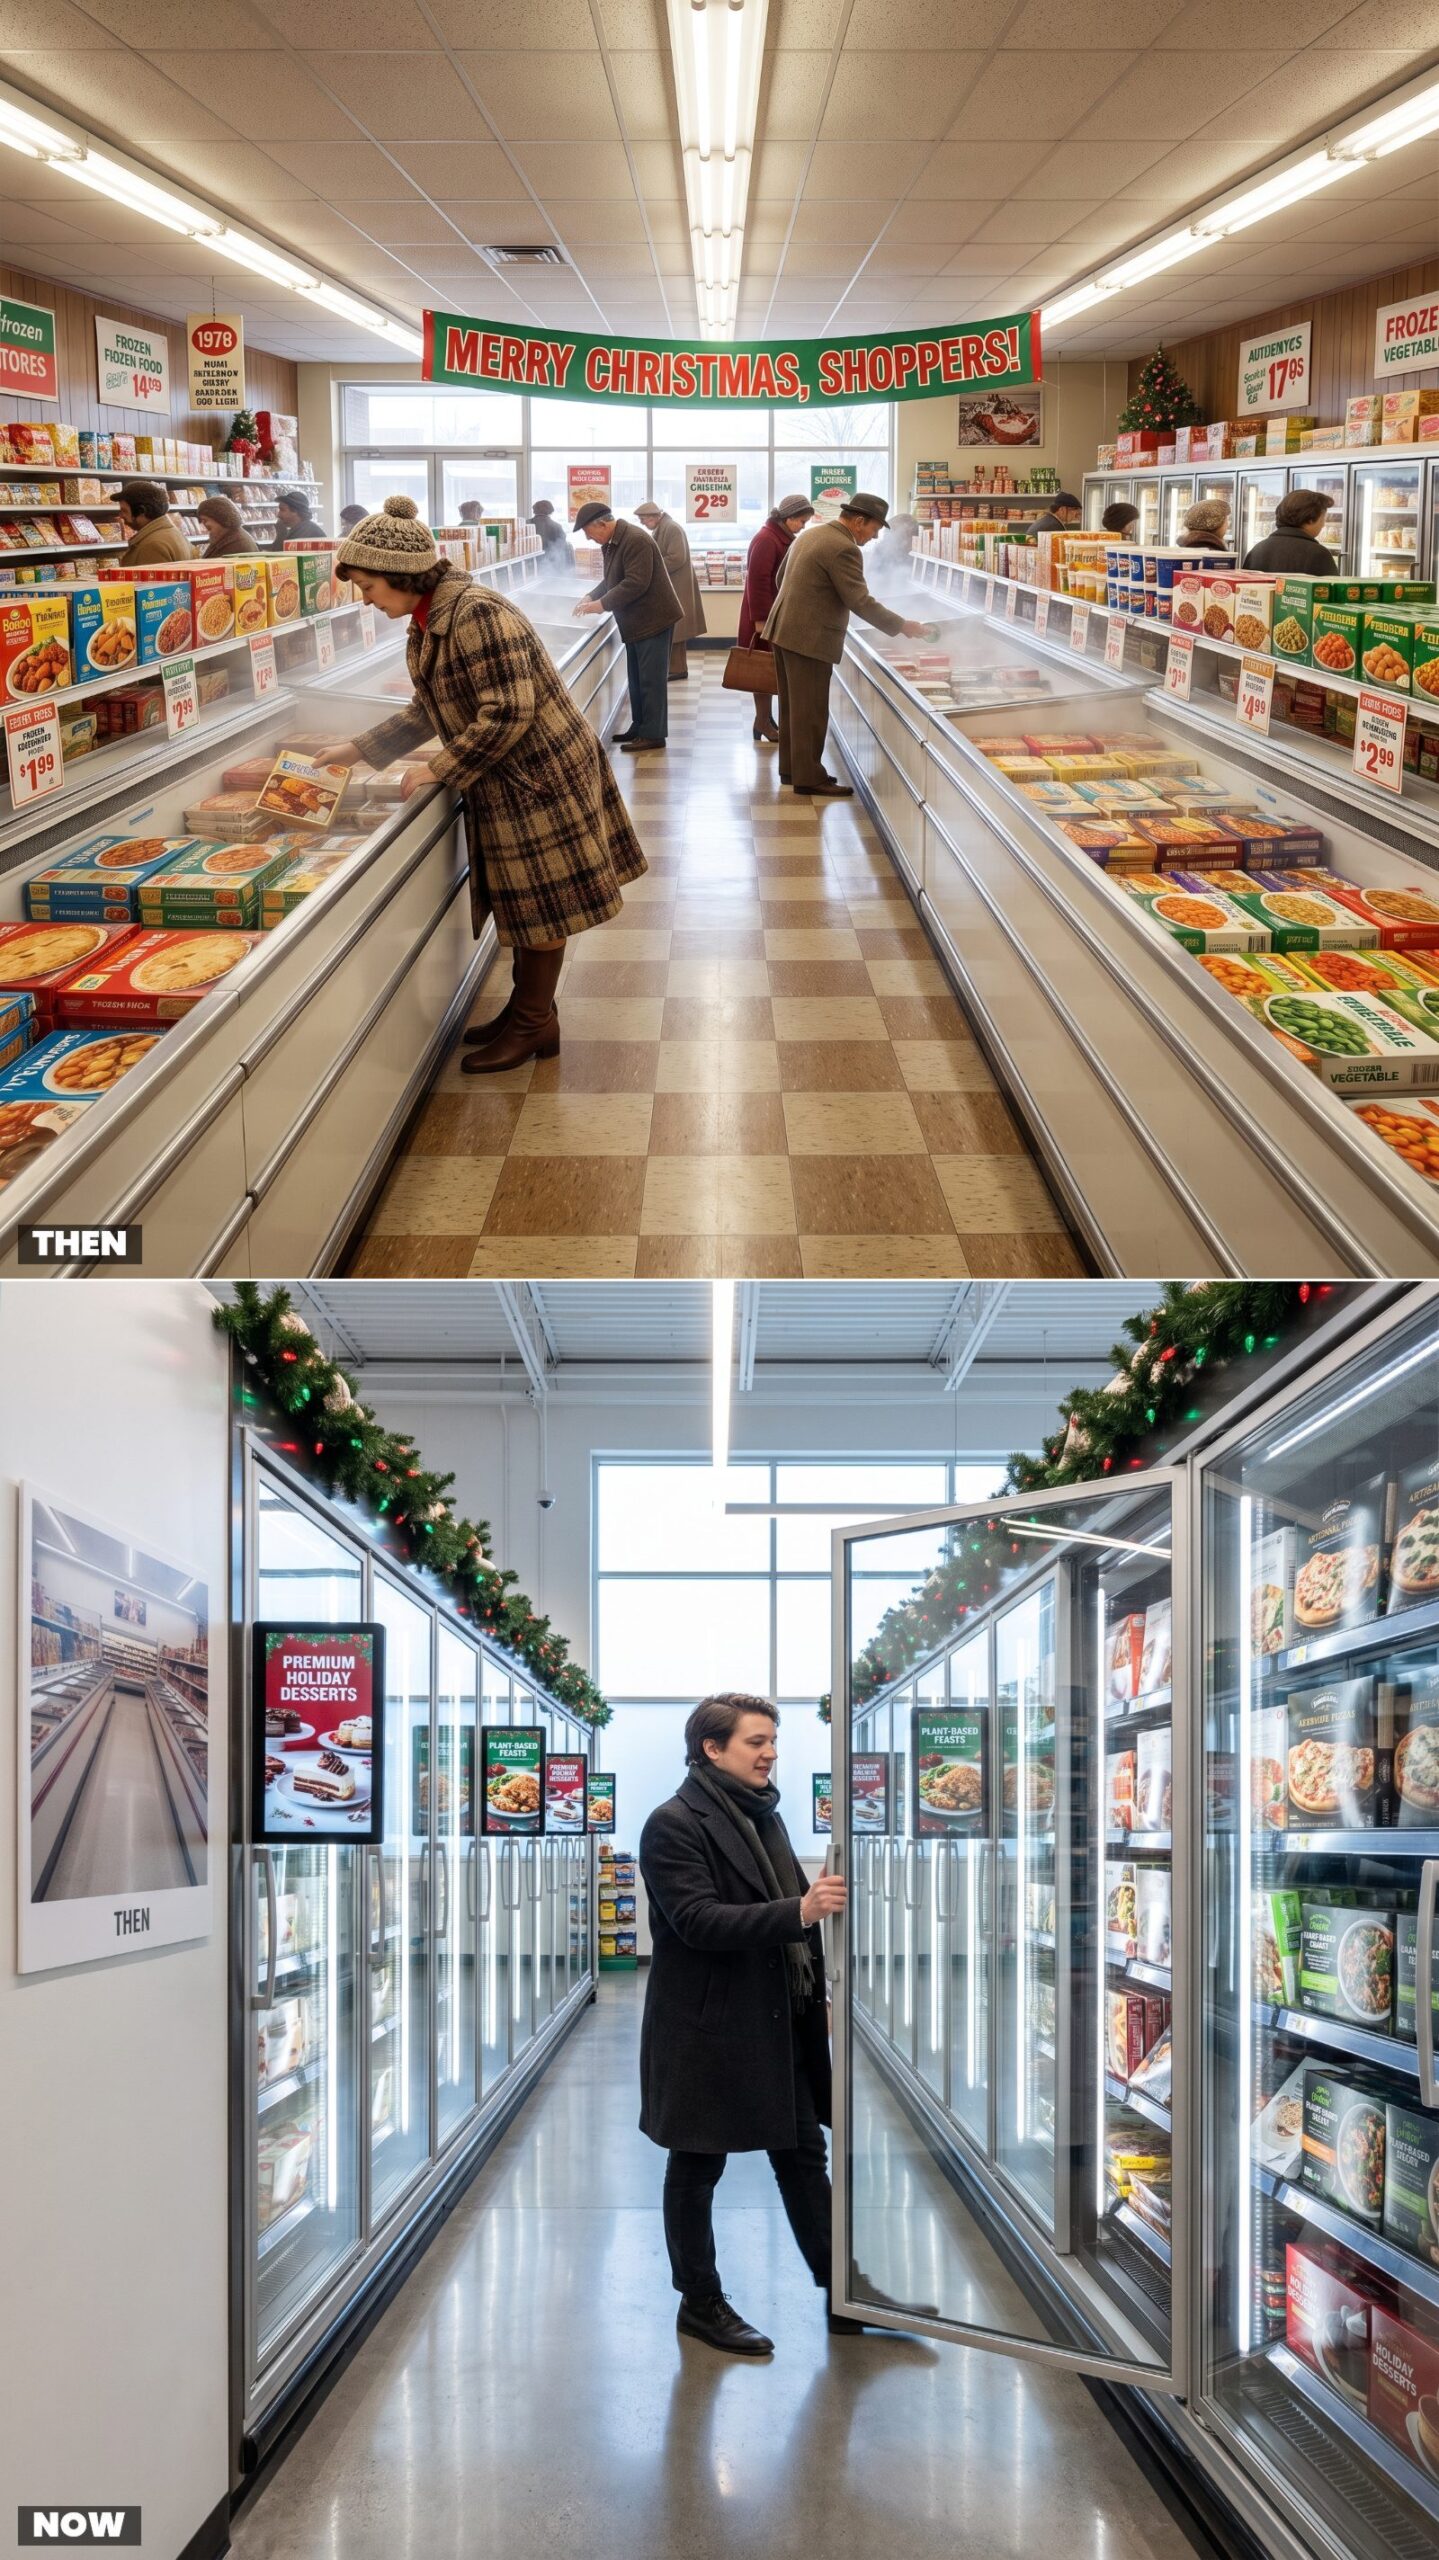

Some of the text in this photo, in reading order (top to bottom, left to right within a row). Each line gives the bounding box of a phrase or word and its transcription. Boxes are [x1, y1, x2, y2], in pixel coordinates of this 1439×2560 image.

[115, 334, 151, 357] FROZEN
[197, 331, 233, 348] 1978
[1384, 337, 1439, 363] VEGETABL
[0, 347, 47, 378] TORES
[139, 357, 163, 375] FOOD
[444, 325, 1021, 403] MERRY CHRISTMAS, SHOPPERS!
[1360, 739, 1395, 774] $299
[20, 753, 55, 791] $199
[1330, 1071, 1399, 1083] VEGETABLE
[282, 1655, 356, 1670] PREMIUM
[286, 1671, 352, 1686] HOLIDAY
[280, 1686, 357, 1702] DESSERTS
[921, 1727, 979, 1736] PLANT-BASED
[934, 1735, 966, 1744] FEASTS
[489, 1742, 538, 1750] PLANT-BASED
[499, 1749, 527, 1757] FEASTS
[113, 1907, 151, 1936] THEN
[1375, 2341, 1415, 2378] HOLIDAY
[1372, 2352, 1417, 2397] DESSERTS
